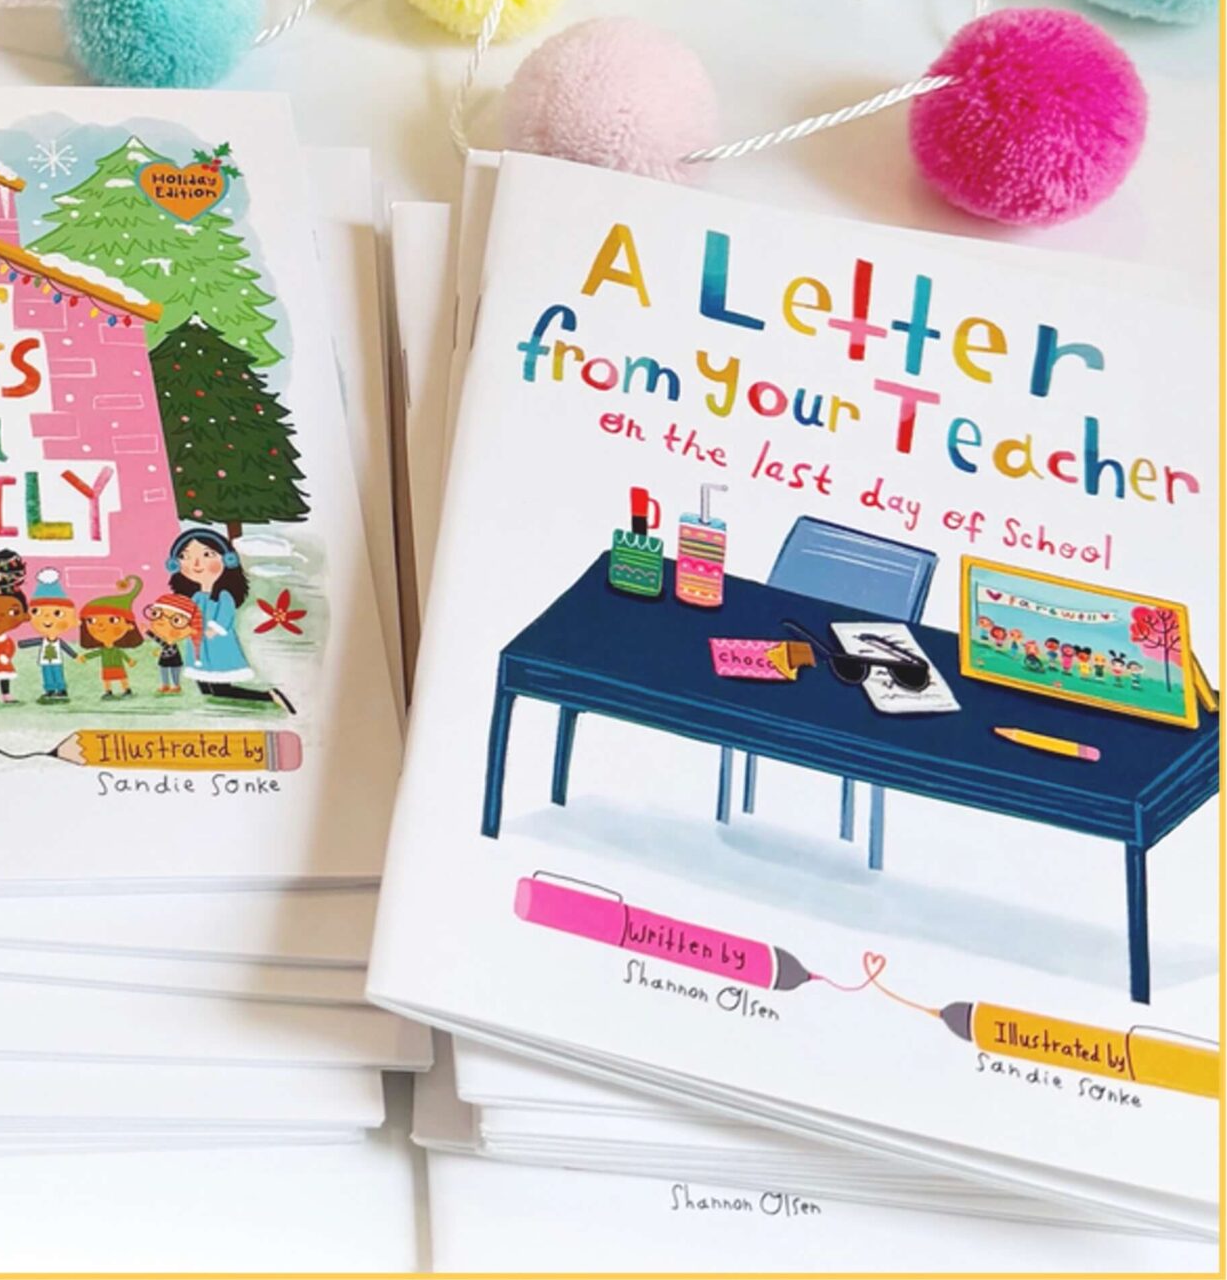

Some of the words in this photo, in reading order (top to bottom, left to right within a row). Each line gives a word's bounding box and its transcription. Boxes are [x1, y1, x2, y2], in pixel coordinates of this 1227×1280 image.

[152, 173, 217, 187] Holiday
[155, 186, 218, 199] Edition
[580, 223, 651, 307] A
[699, 230, 1104, 397] Letter
[517, 304, 681, 401] from
[875, 379, 1200, 504] Teacher
[599, 413, 646, 440] on
[664, 424, 727, 467] the
[752, 440, 832, 495] last
[861, 477, 922, 531] day
[943, 508, 985, 543] of
[1003, 518, 1112, 570] School
[96, 733, 231, 763] Illustrated
[243, 745, 264, 763] by
[97, 771, 195, 796] Sandie
[212, 773, 281, 796] Sonke
[722, 942, 746, 970] by
[623, 959, 709, 1002] Shannon
[716, 986, 780, 1021] Olsen
[994, 1021, 1101, 1063] Illustrated
[1107, 1043, 1126, 1073] by
[975, 1052, 1064, 1090] Sandie
[1078, 1077, 1143, 1109] Sonke
[671, 1184, 753, 1212] Shannon
[760, 1191, 822, 1217] Olsen
